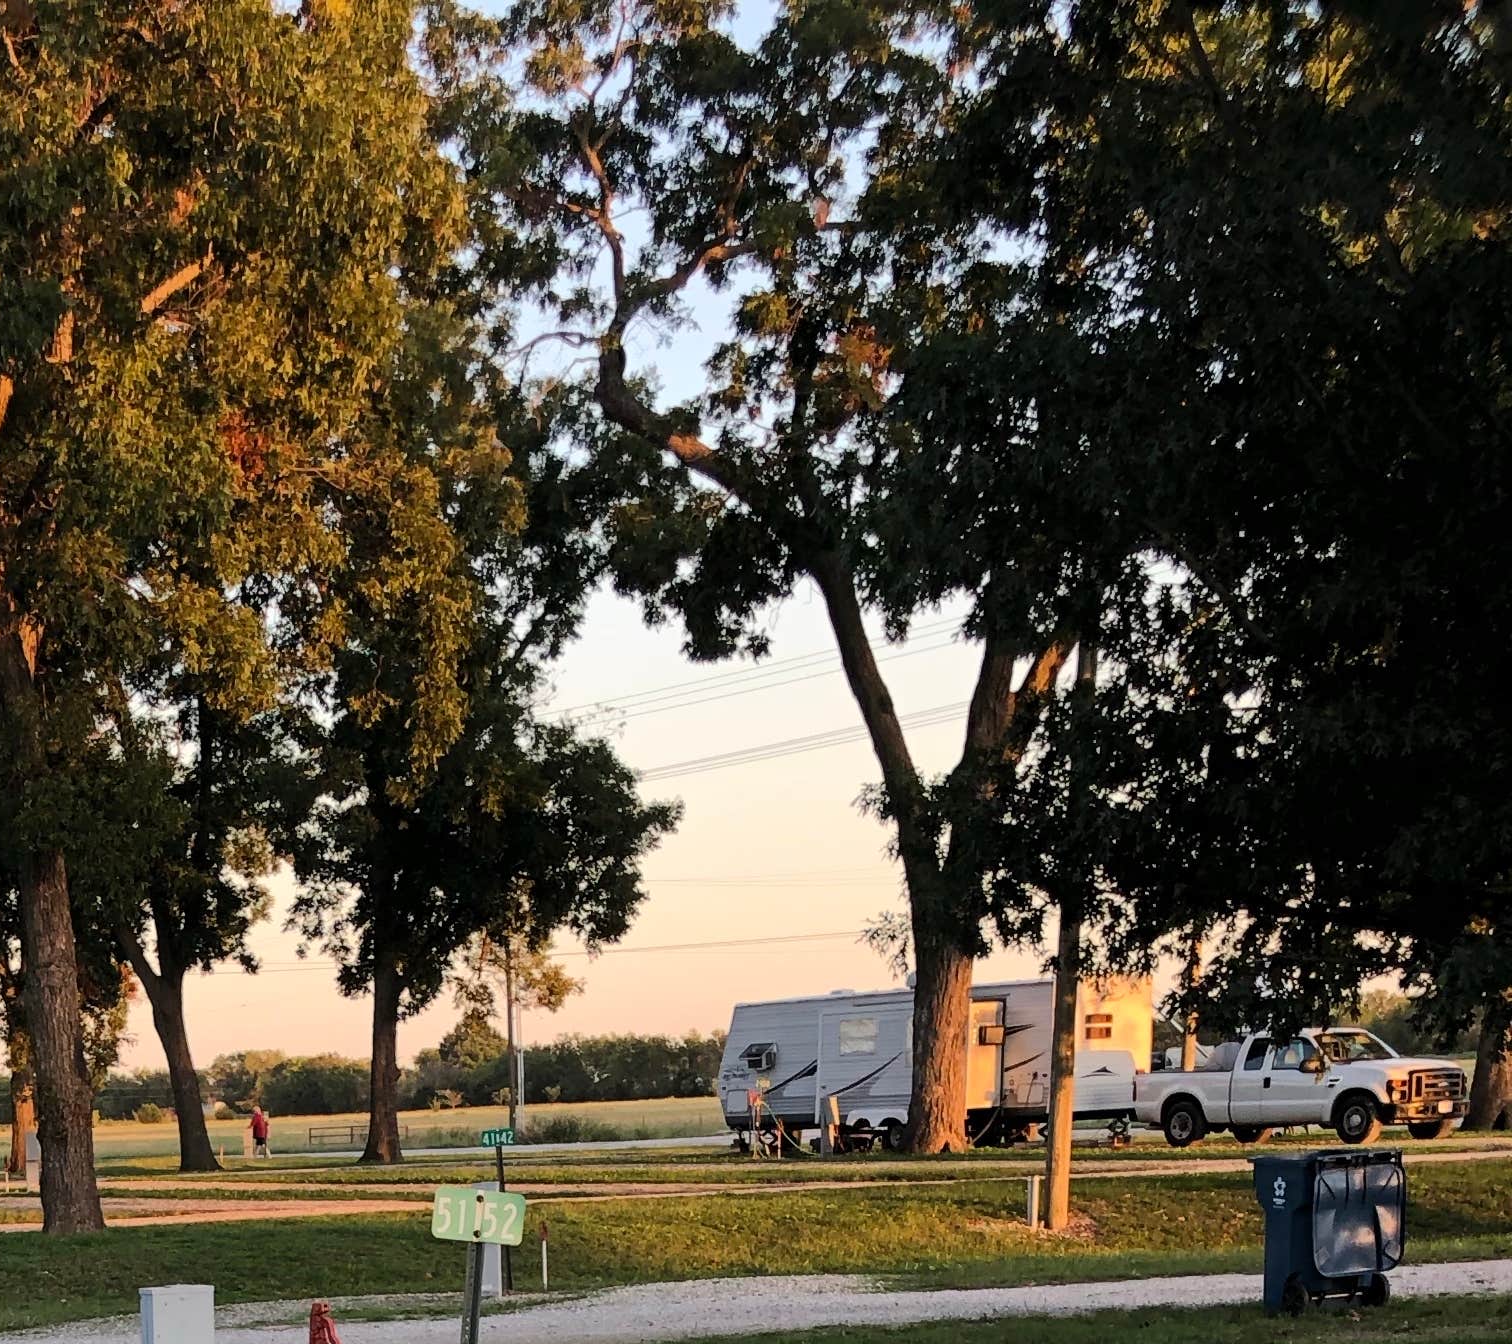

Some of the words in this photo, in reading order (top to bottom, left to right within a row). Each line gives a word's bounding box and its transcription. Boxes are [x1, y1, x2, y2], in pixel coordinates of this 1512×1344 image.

[482, 1132, 495, 1145] 41
[501, 1131, 514, 1144] 42
[437, 1197, 467, 1235] 51
[483, 1202, 517, 1240] 52
